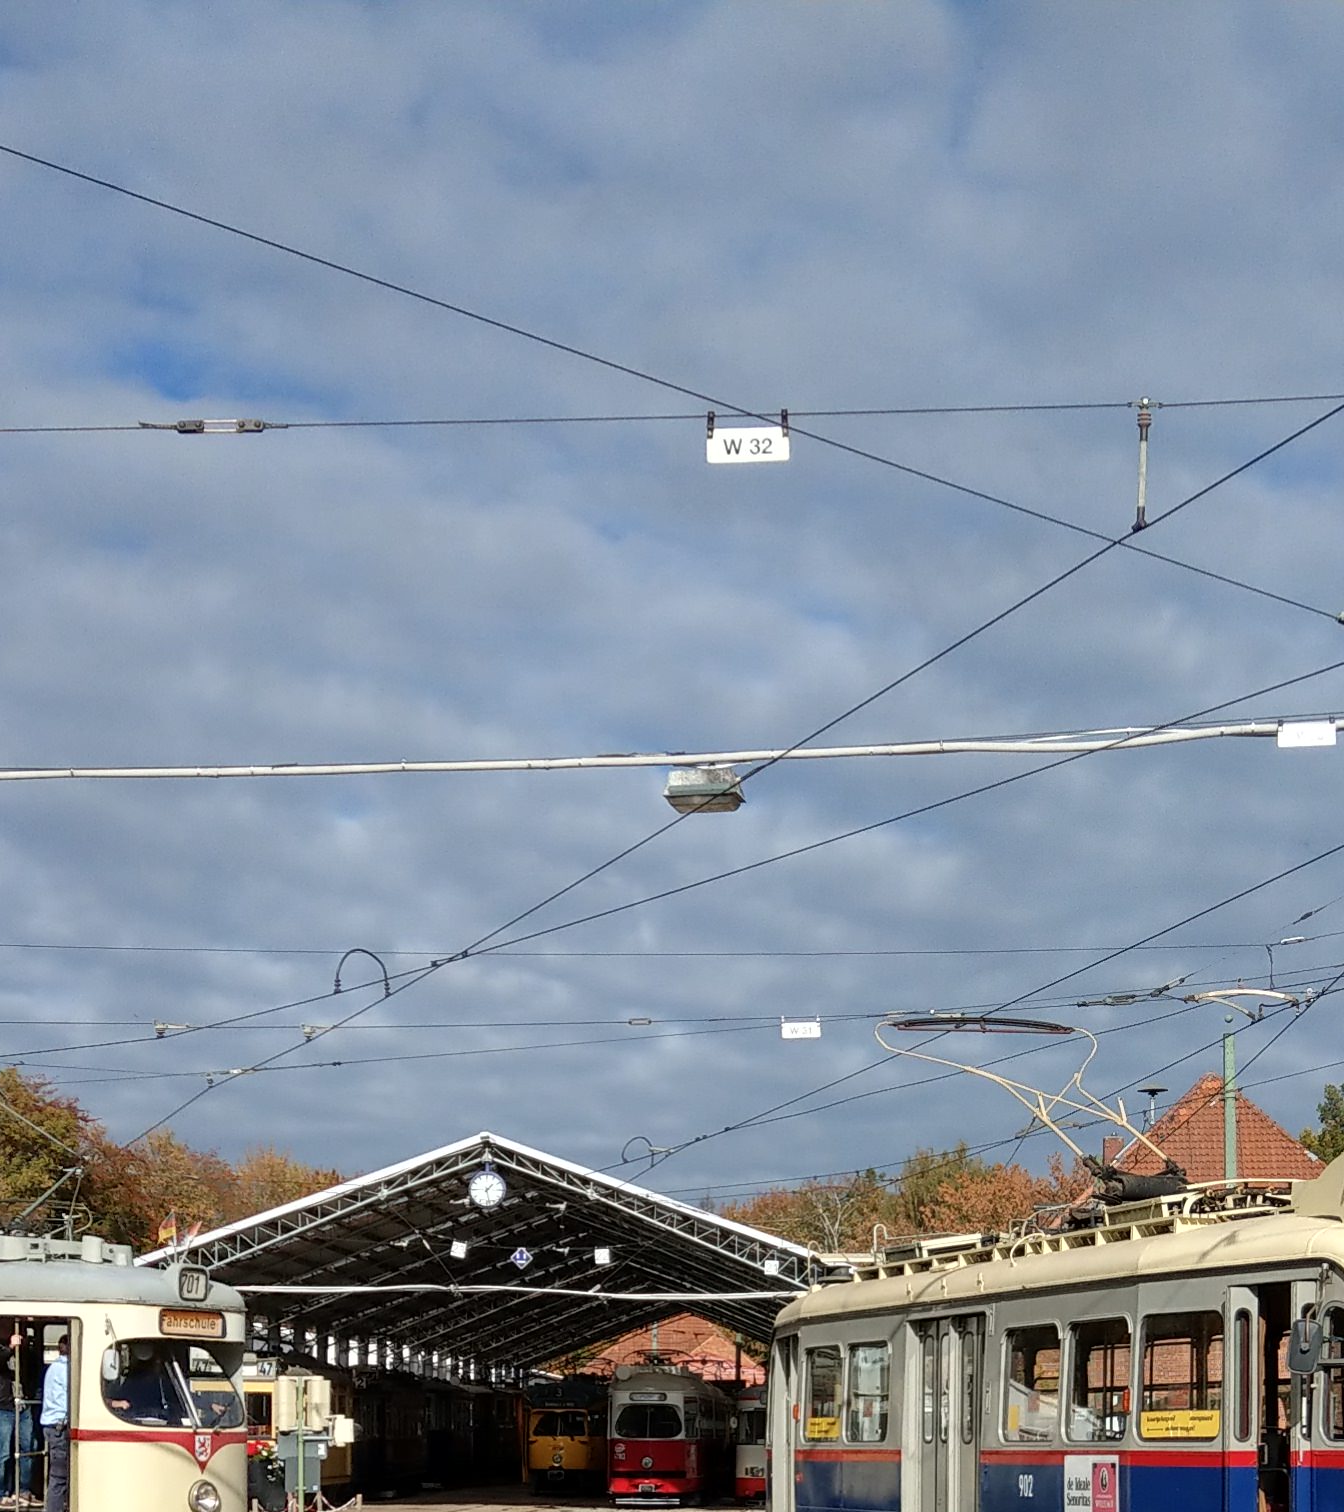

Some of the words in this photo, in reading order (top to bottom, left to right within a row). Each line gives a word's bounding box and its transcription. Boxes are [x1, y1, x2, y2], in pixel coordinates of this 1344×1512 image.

[723, 438, 742, 455] W
[749, 437, 773, 455] 32
[181, 1273, 200, 1296] 701
[162, 1313, 216, 1330] Fahrschule
[259, 1361, 273, 1376] 47
[1018, 1474, 1034, 1498] 902
[1067, 1477, 1074, 1491] de
